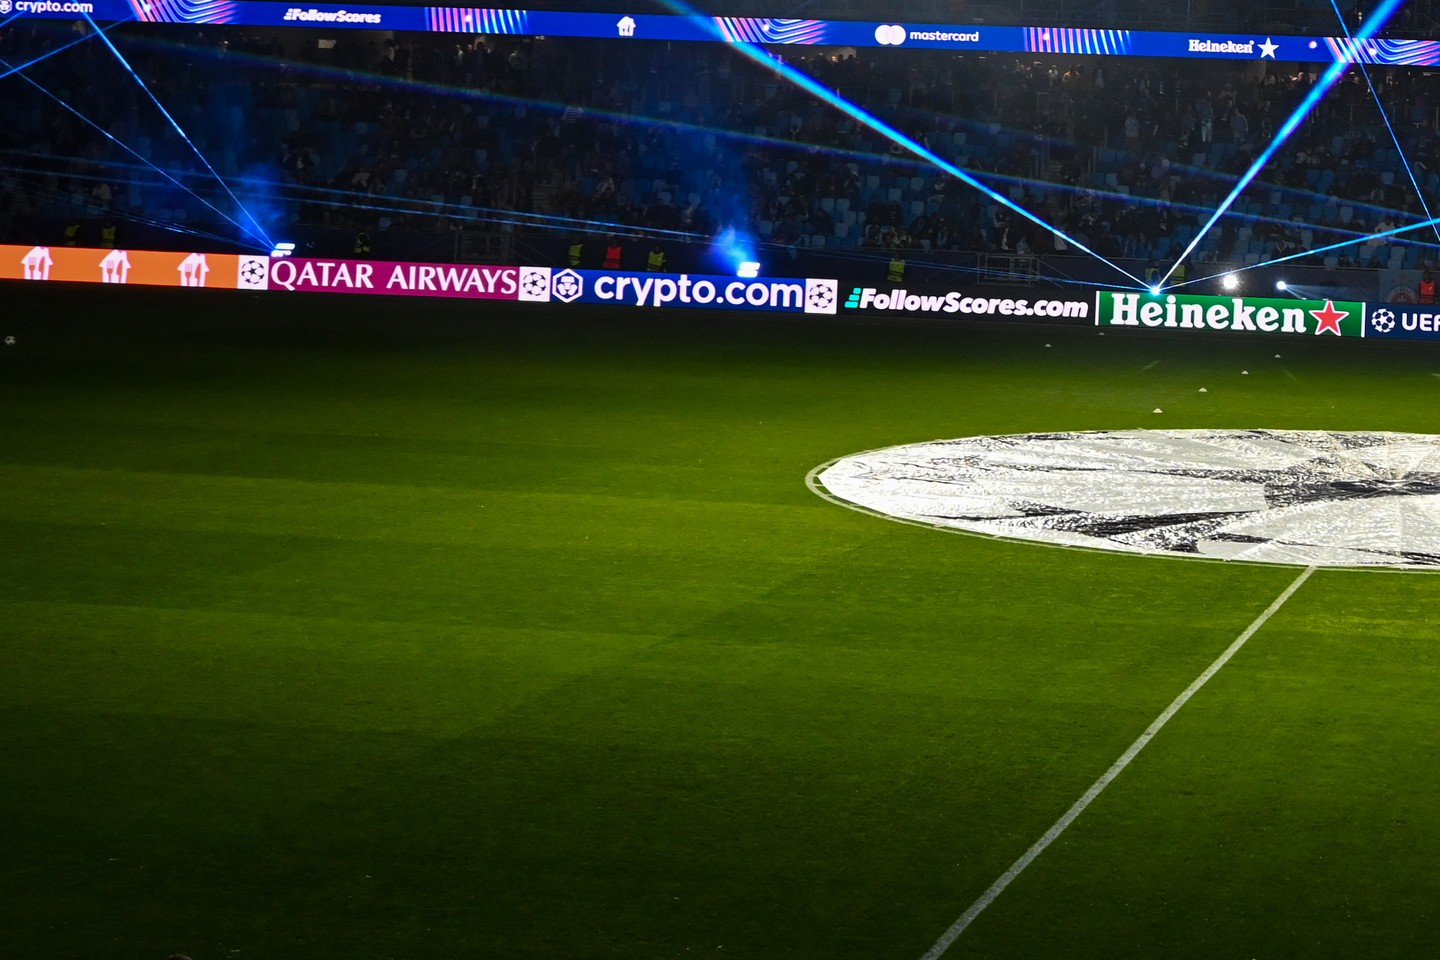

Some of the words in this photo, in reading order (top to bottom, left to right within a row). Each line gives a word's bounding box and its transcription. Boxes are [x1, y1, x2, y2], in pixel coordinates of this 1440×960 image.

[15, 0, 93, 13] crypto.com
[292, 8, 381, 23] FollowScores
[910, 30, 979, 42] mastercard
[1188, 39, 1253, 54] Heineken
[271, 260, 374, 291] QATAR
[386, 266, 517, 295] AIRWAYS
[594, 274, 803, 307] crypto.com
[859, 288, 1089, 318] FollowScores.com
[1110, 293, 1307, 333] Heineken
